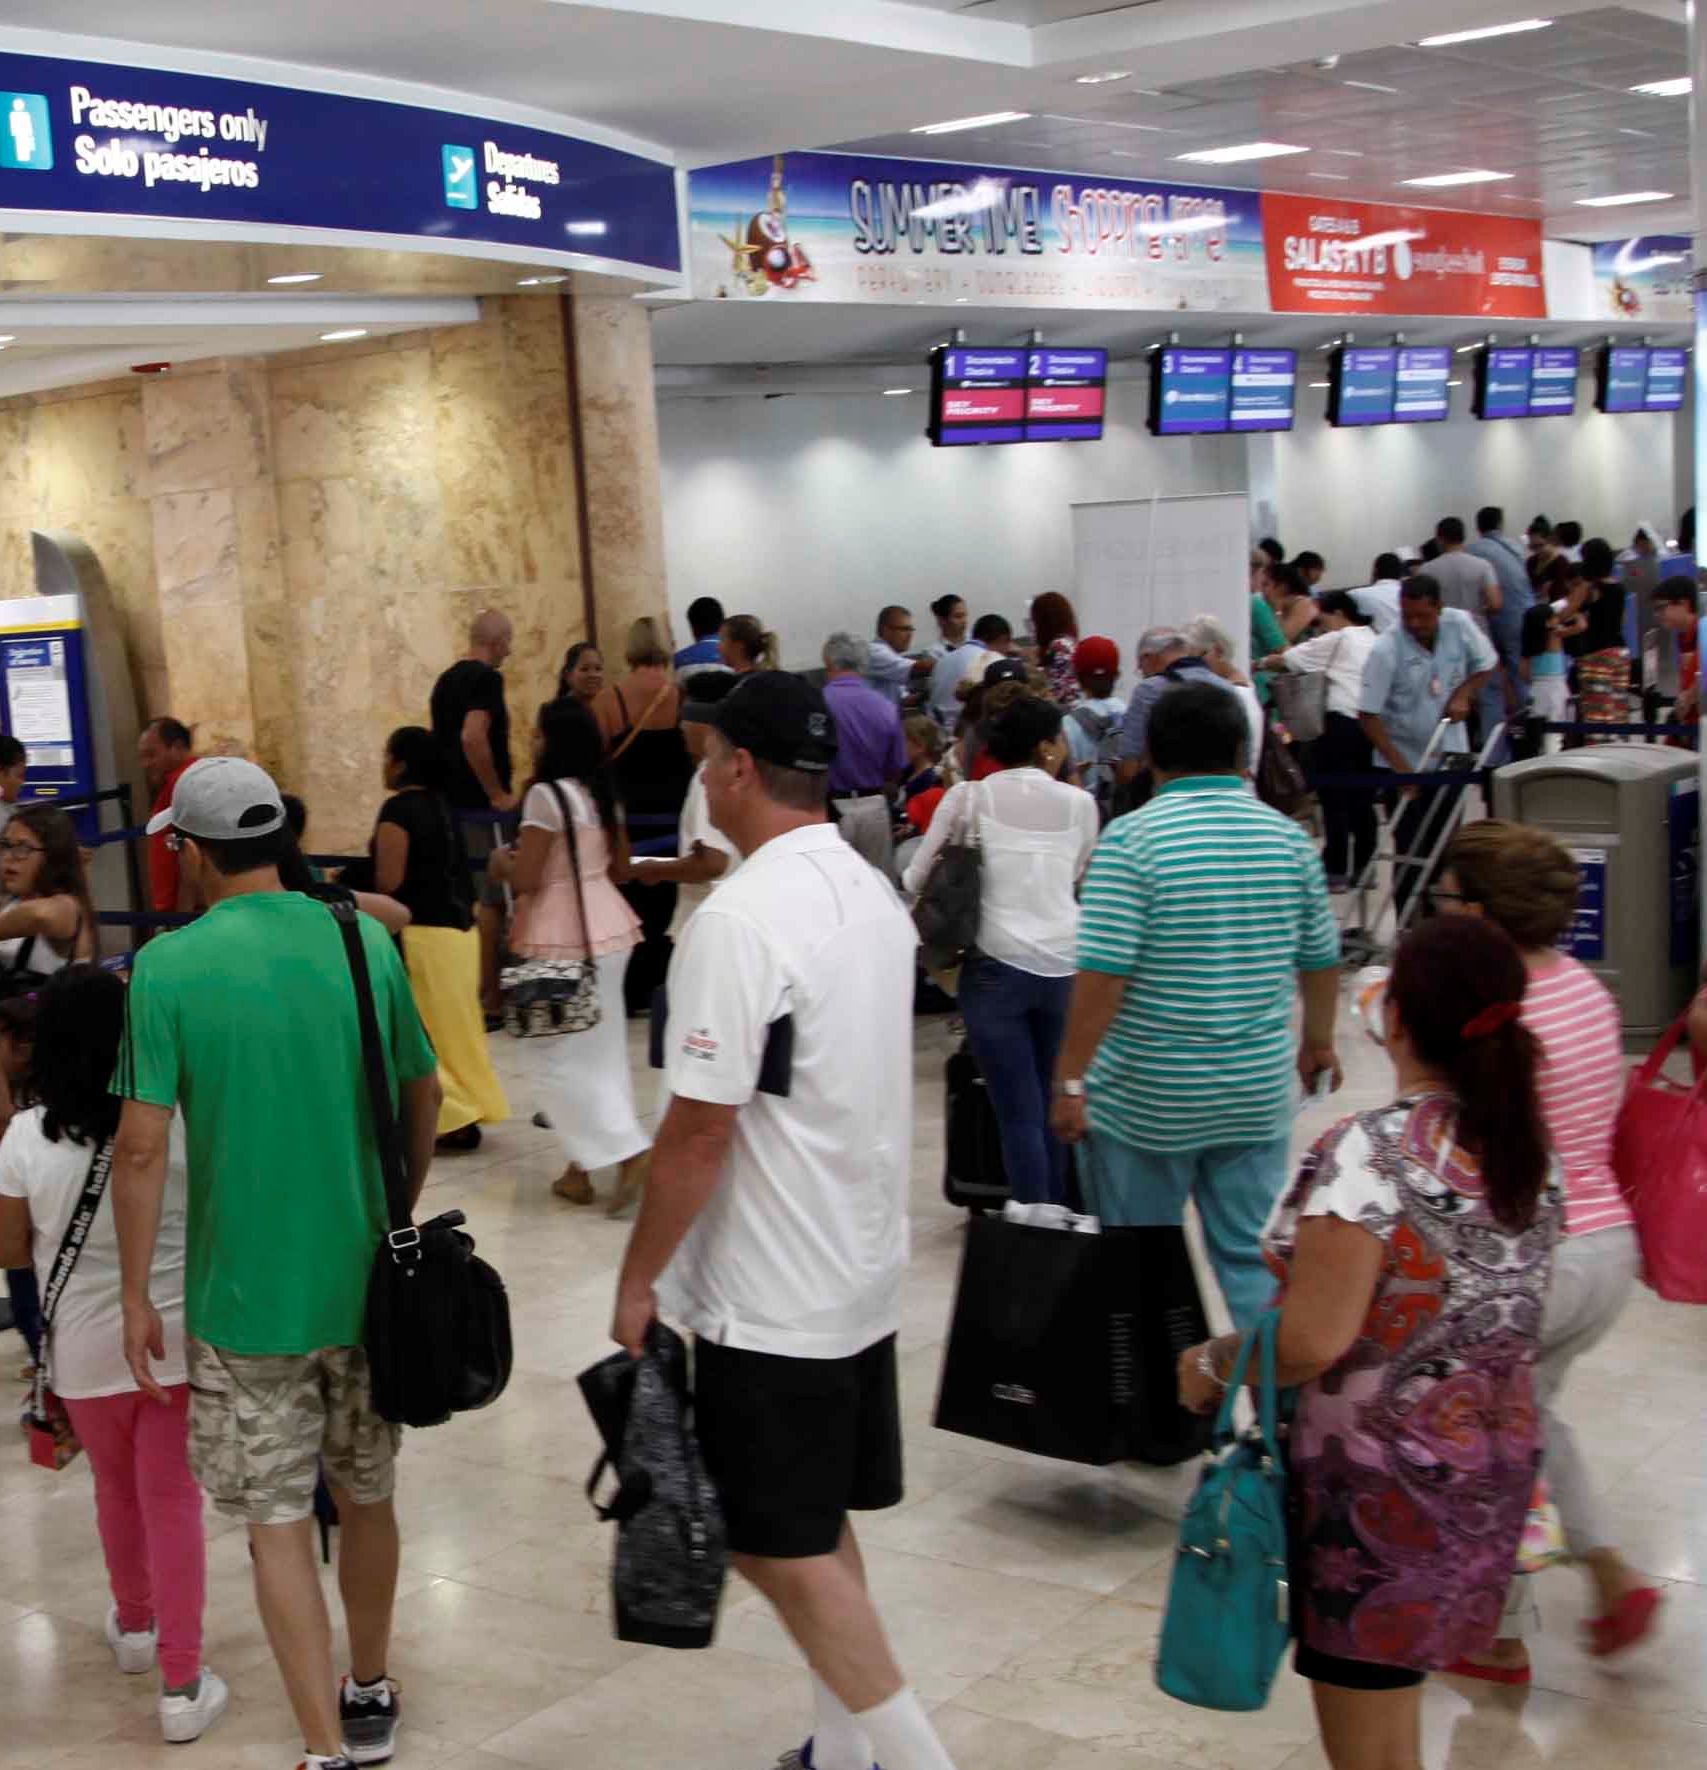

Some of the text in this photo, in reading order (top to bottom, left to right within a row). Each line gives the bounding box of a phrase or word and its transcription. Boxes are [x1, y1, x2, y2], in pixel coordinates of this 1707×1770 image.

[69, 86, 268, 152] Passengers only
[74, 134, 259, 192] Solo pasajeros
[483, 140, 561, 185] Departures
[486, 181, 542, 219] Salidas
[944, 354, 957, 376] 1
[1028, 354, 1042, 376] 2
[1162, 354, 1174, 374] 3
